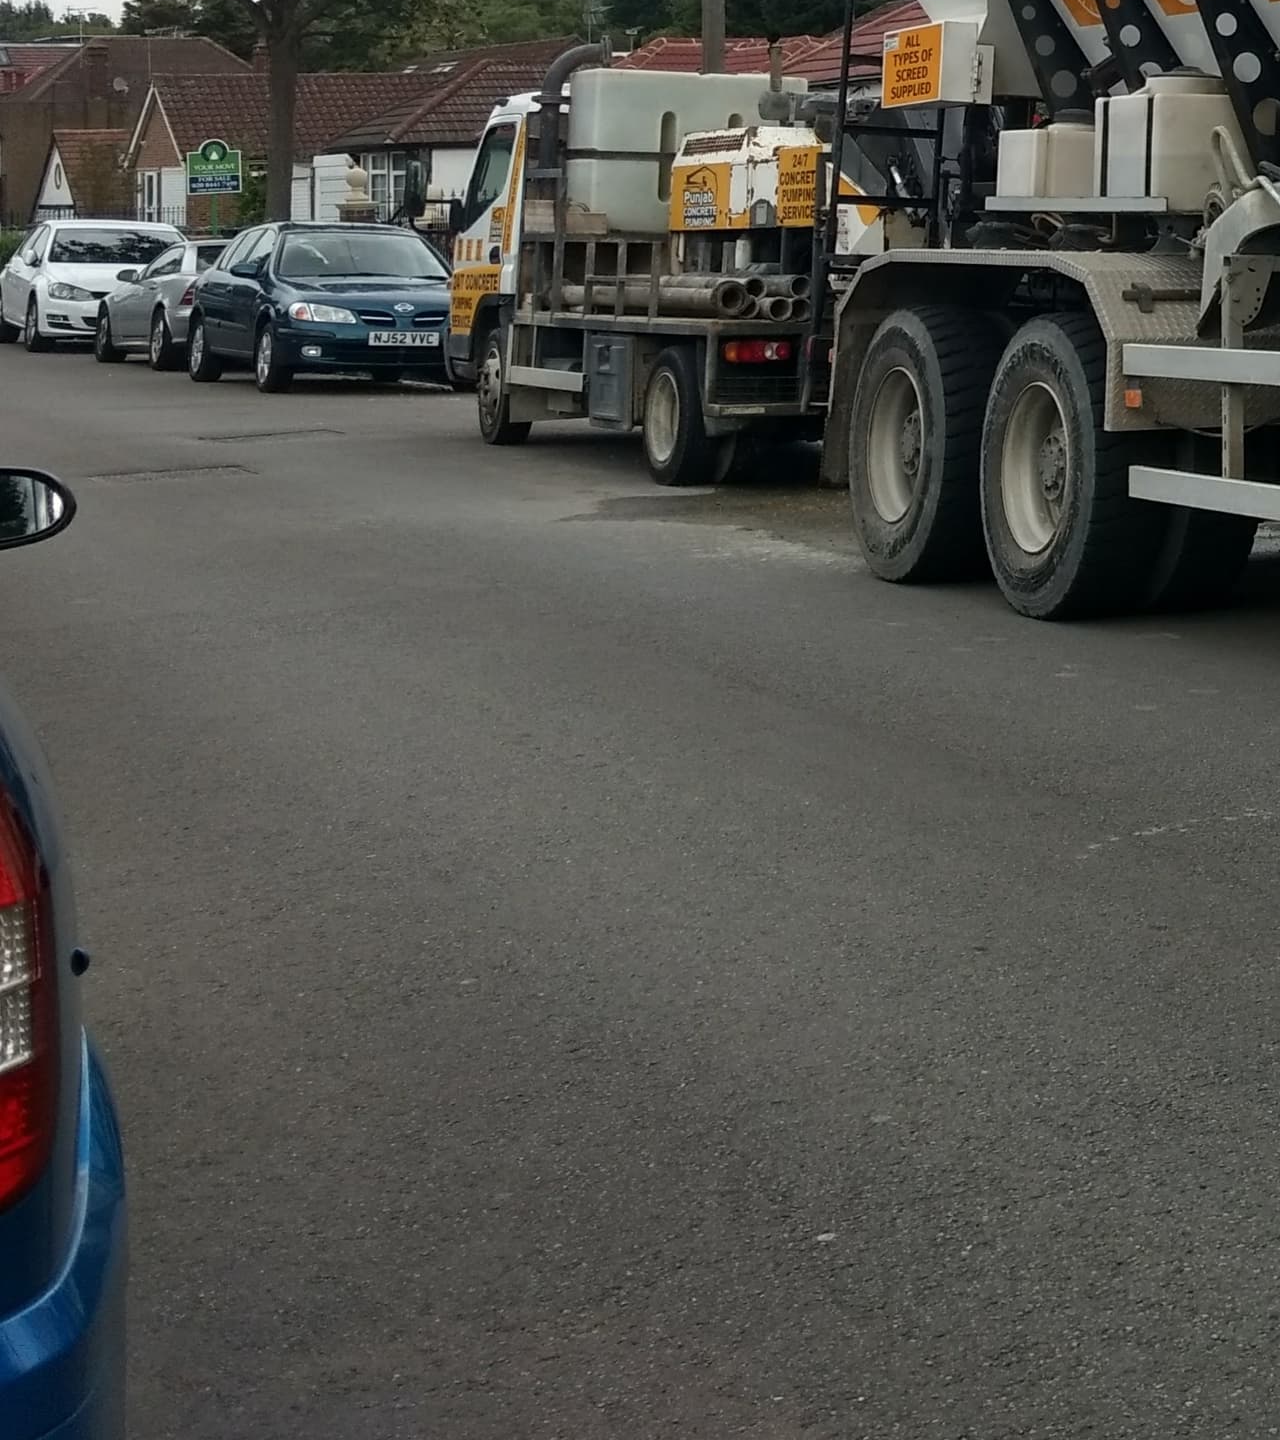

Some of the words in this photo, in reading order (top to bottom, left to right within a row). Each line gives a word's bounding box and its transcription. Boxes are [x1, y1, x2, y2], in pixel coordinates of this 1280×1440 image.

[905, 35, 920, 48] ALL
[893, 50, 919, 66] TYPES
[921, 48, 933, 62] OF
[895, 66, 928, 82] SCREED
[891, 82, 931, 99] SUPPLIED
[792, 153, 808, 168] 24/7
[780, 170, 816, 185] CONCRET
[683, 190, 714, 204] Punjab
[683, 206, 718, 216] CONCRETE
[783, 205, 816, 220] SERVICE
[465, 273, 499, 292] CONCRETE
[373, 333, 407, 344] NJ52
[411, 333, 435, 344] VVC
